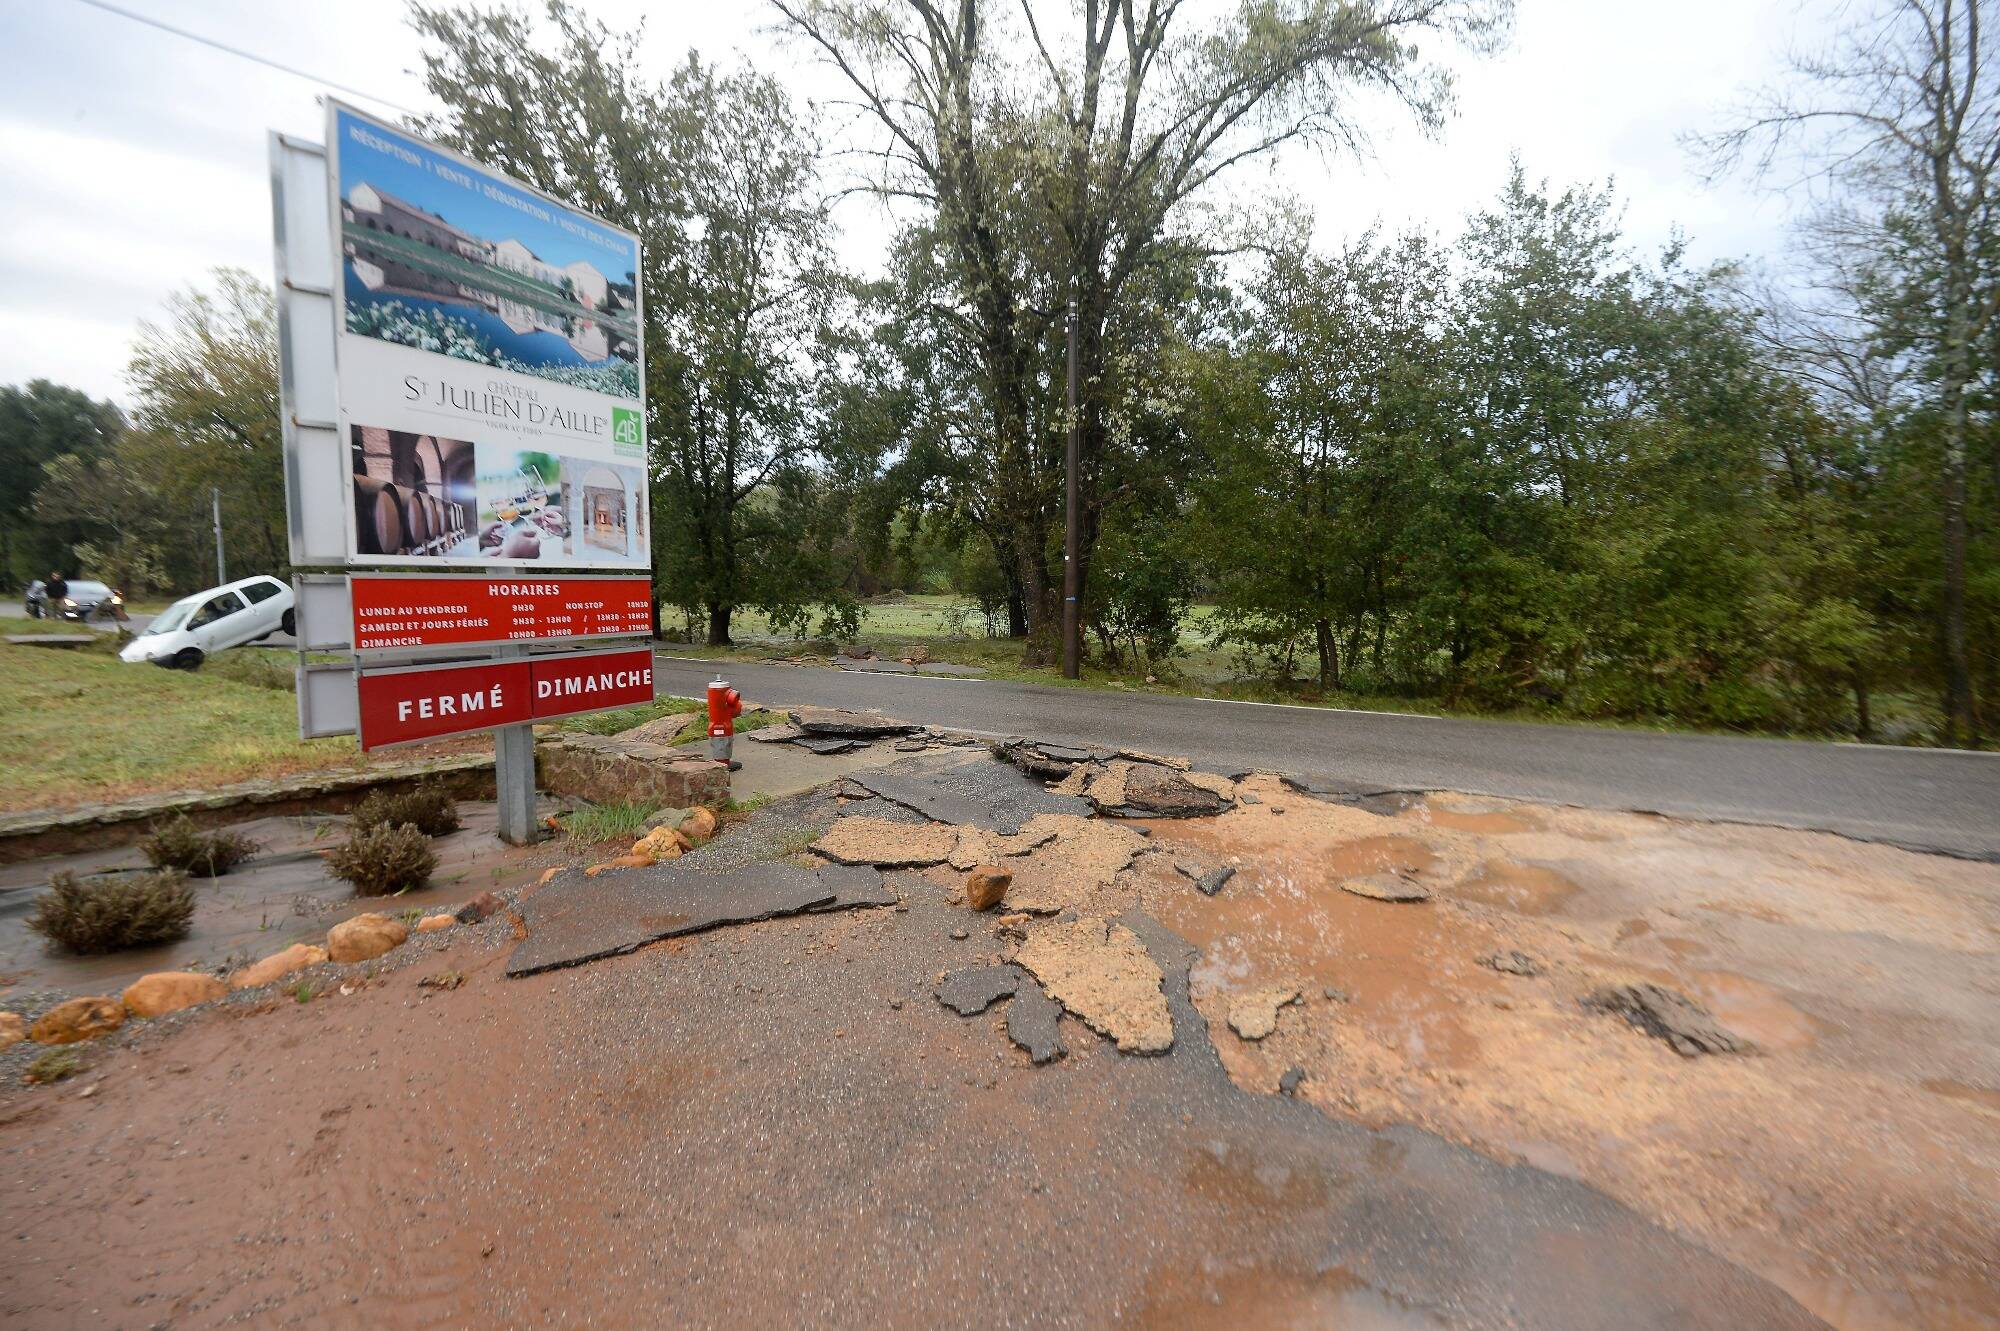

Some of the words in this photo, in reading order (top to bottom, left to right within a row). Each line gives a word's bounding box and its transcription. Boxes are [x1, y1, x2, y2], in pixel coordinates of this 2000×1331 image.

[350, 125, 422, 168] RÉCEPTION
[434, 162, 473, 190] VENTE
[436, 381, 521, 420] JULIEN
[487, 379, 539, 402] CHÂTEAU
[614, 419, 638, 443] AB
[488, 584, 560, 597] HORAIRES
[359, 607, 396, 617] LUNDI
[398, 606, 413, 615] AU
[415, 605, 468, 615] VENDREDI
[512, 604, 535, 612] 9H30
[565, 602, 584, 610] NON
[360, 623, 404, 633] SAMEDI
[407, 622, 419, 631] ET
[421, 620, 455, 630] JOURS
[456, 617, 489, 628] FÉRIÉS
[512, 617, 535, 625] 9H30
[361, 637, 423, 648] DIMANCHE
[398, 683, 504, 722] FERMÉ
[537, 668, 652, 699] DIMANCHE
